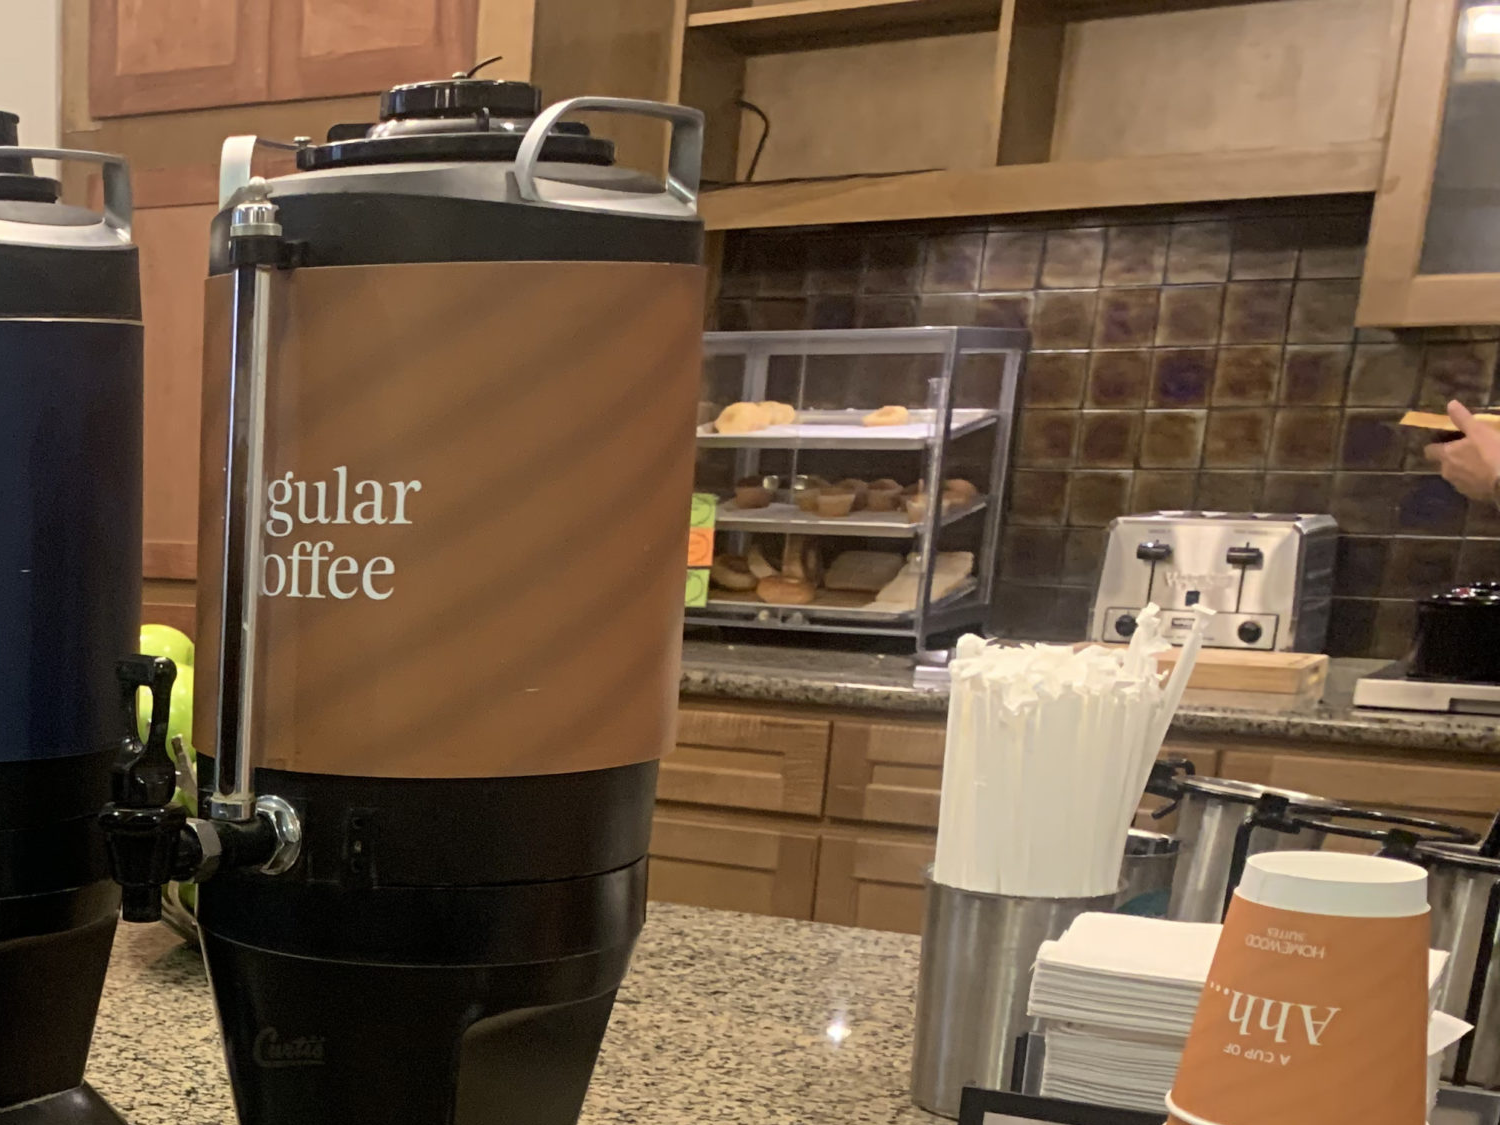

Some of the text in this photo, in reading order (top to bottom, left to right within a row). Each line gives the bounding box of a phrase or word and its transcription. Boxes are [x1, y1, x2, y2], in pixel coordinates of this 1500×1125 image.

[265, 465, 422, 537] gular
[262, 540, 395, 600] offee
[1245, 933, 1326, 959] HOMEWOOD
[1223, 1042, 1291, 1066] A CUP OF
